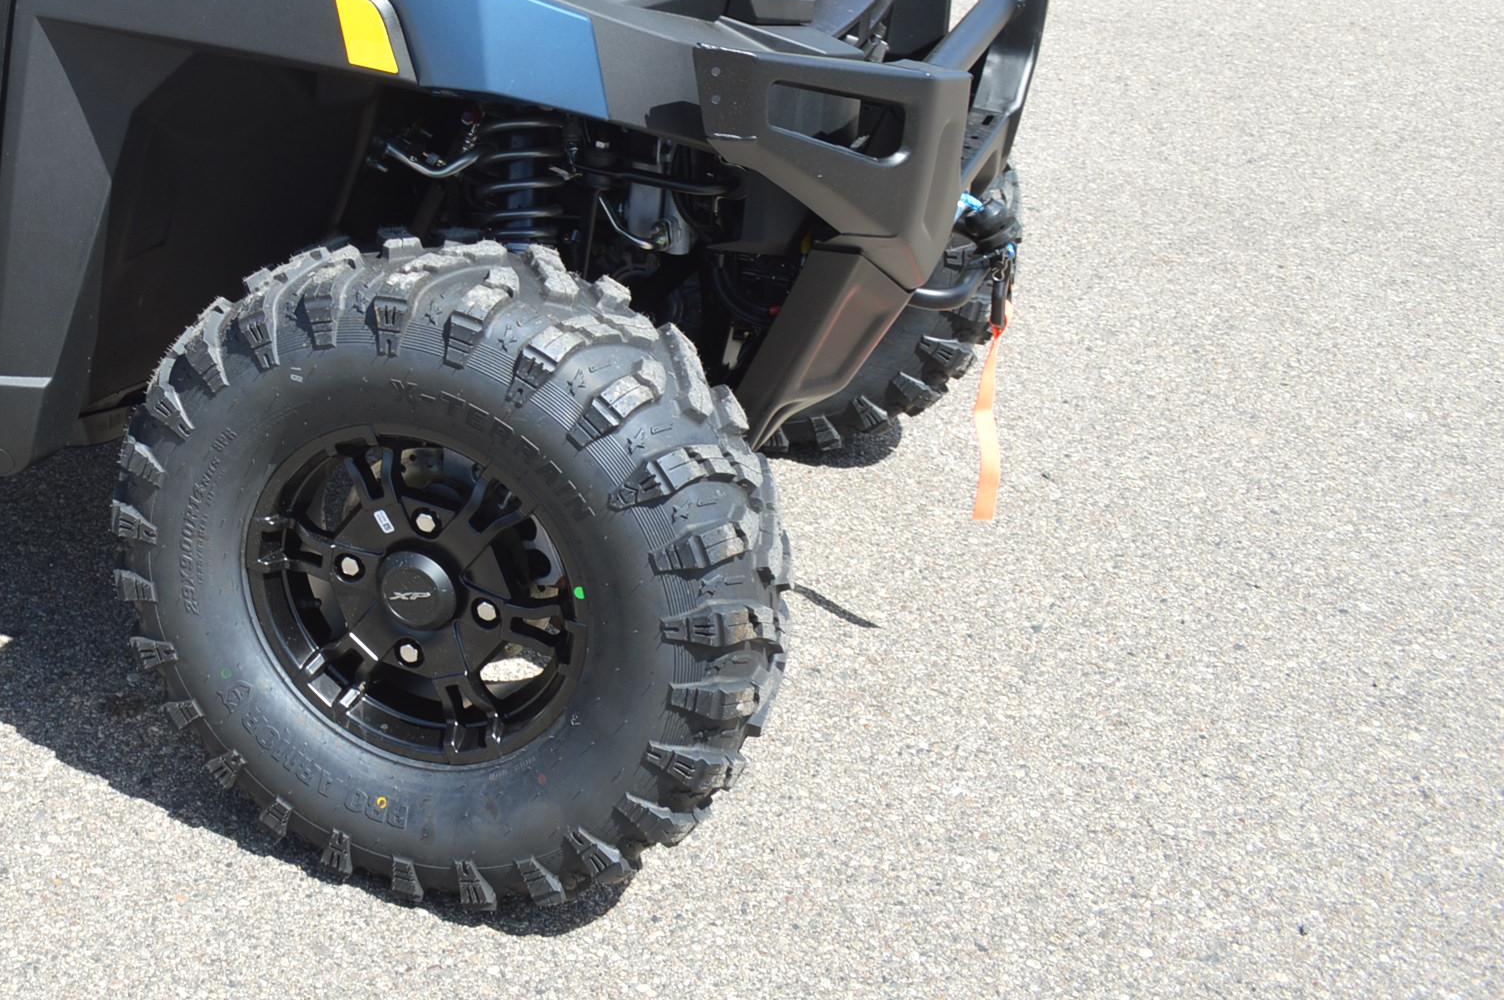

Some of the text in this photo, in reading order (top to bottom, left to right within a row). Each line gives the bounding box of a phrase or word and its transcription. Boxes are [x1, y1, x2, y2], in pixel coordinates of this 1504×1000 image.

[390, 378, 596, 522] X-TERRAIN
[388, 591, 432, 601] XP
[241, 706, 409, 831] PRO ARMOR
